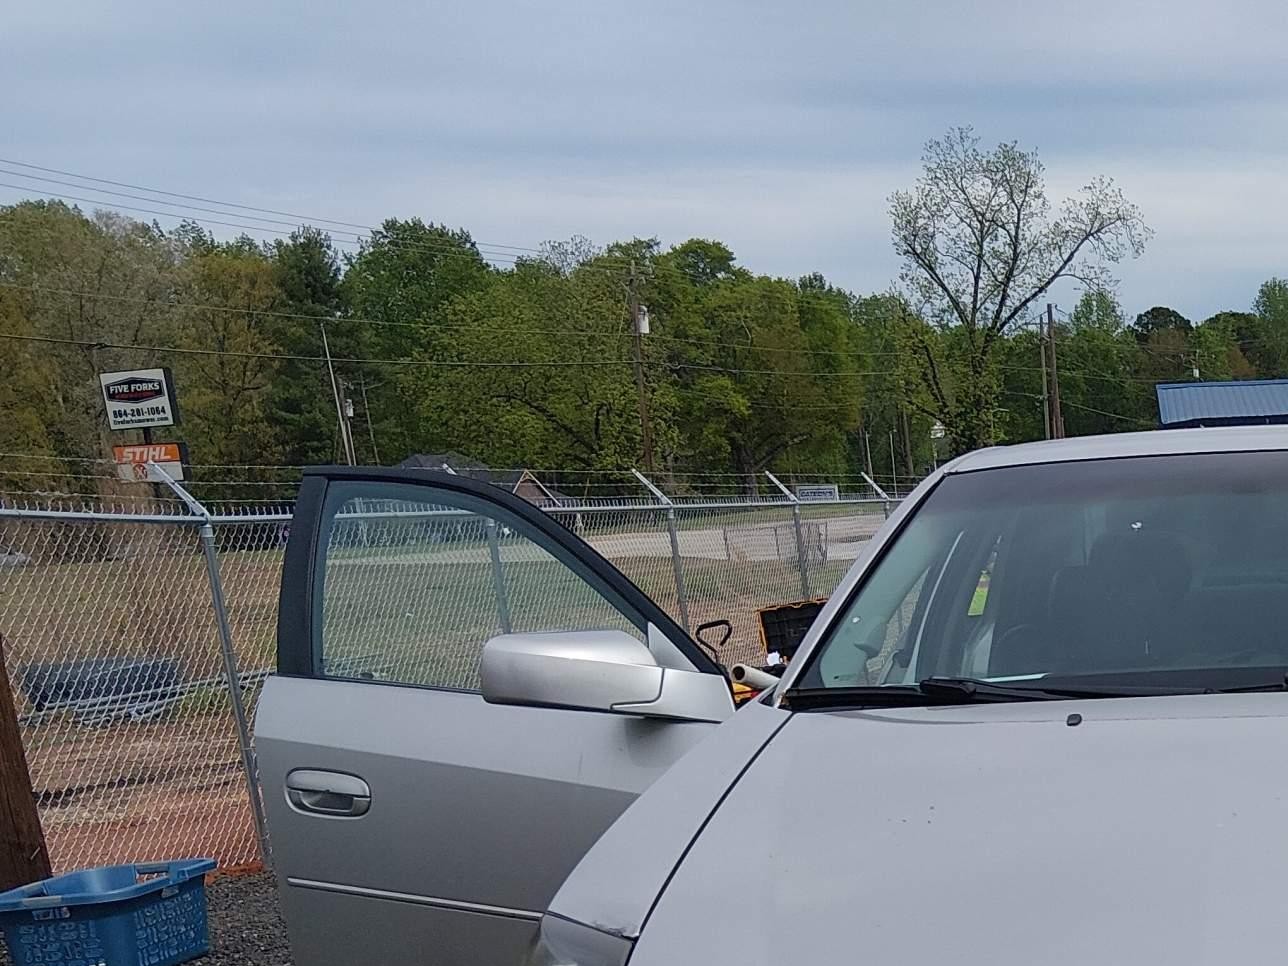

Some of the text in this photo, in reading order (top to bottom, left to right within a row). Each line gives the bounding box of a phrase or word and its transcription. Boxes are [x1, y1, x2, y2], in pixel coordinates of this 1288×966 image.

[109, 382, 160, 394] FIVE FORKS
[122, 446, 172, 461] STIHL
